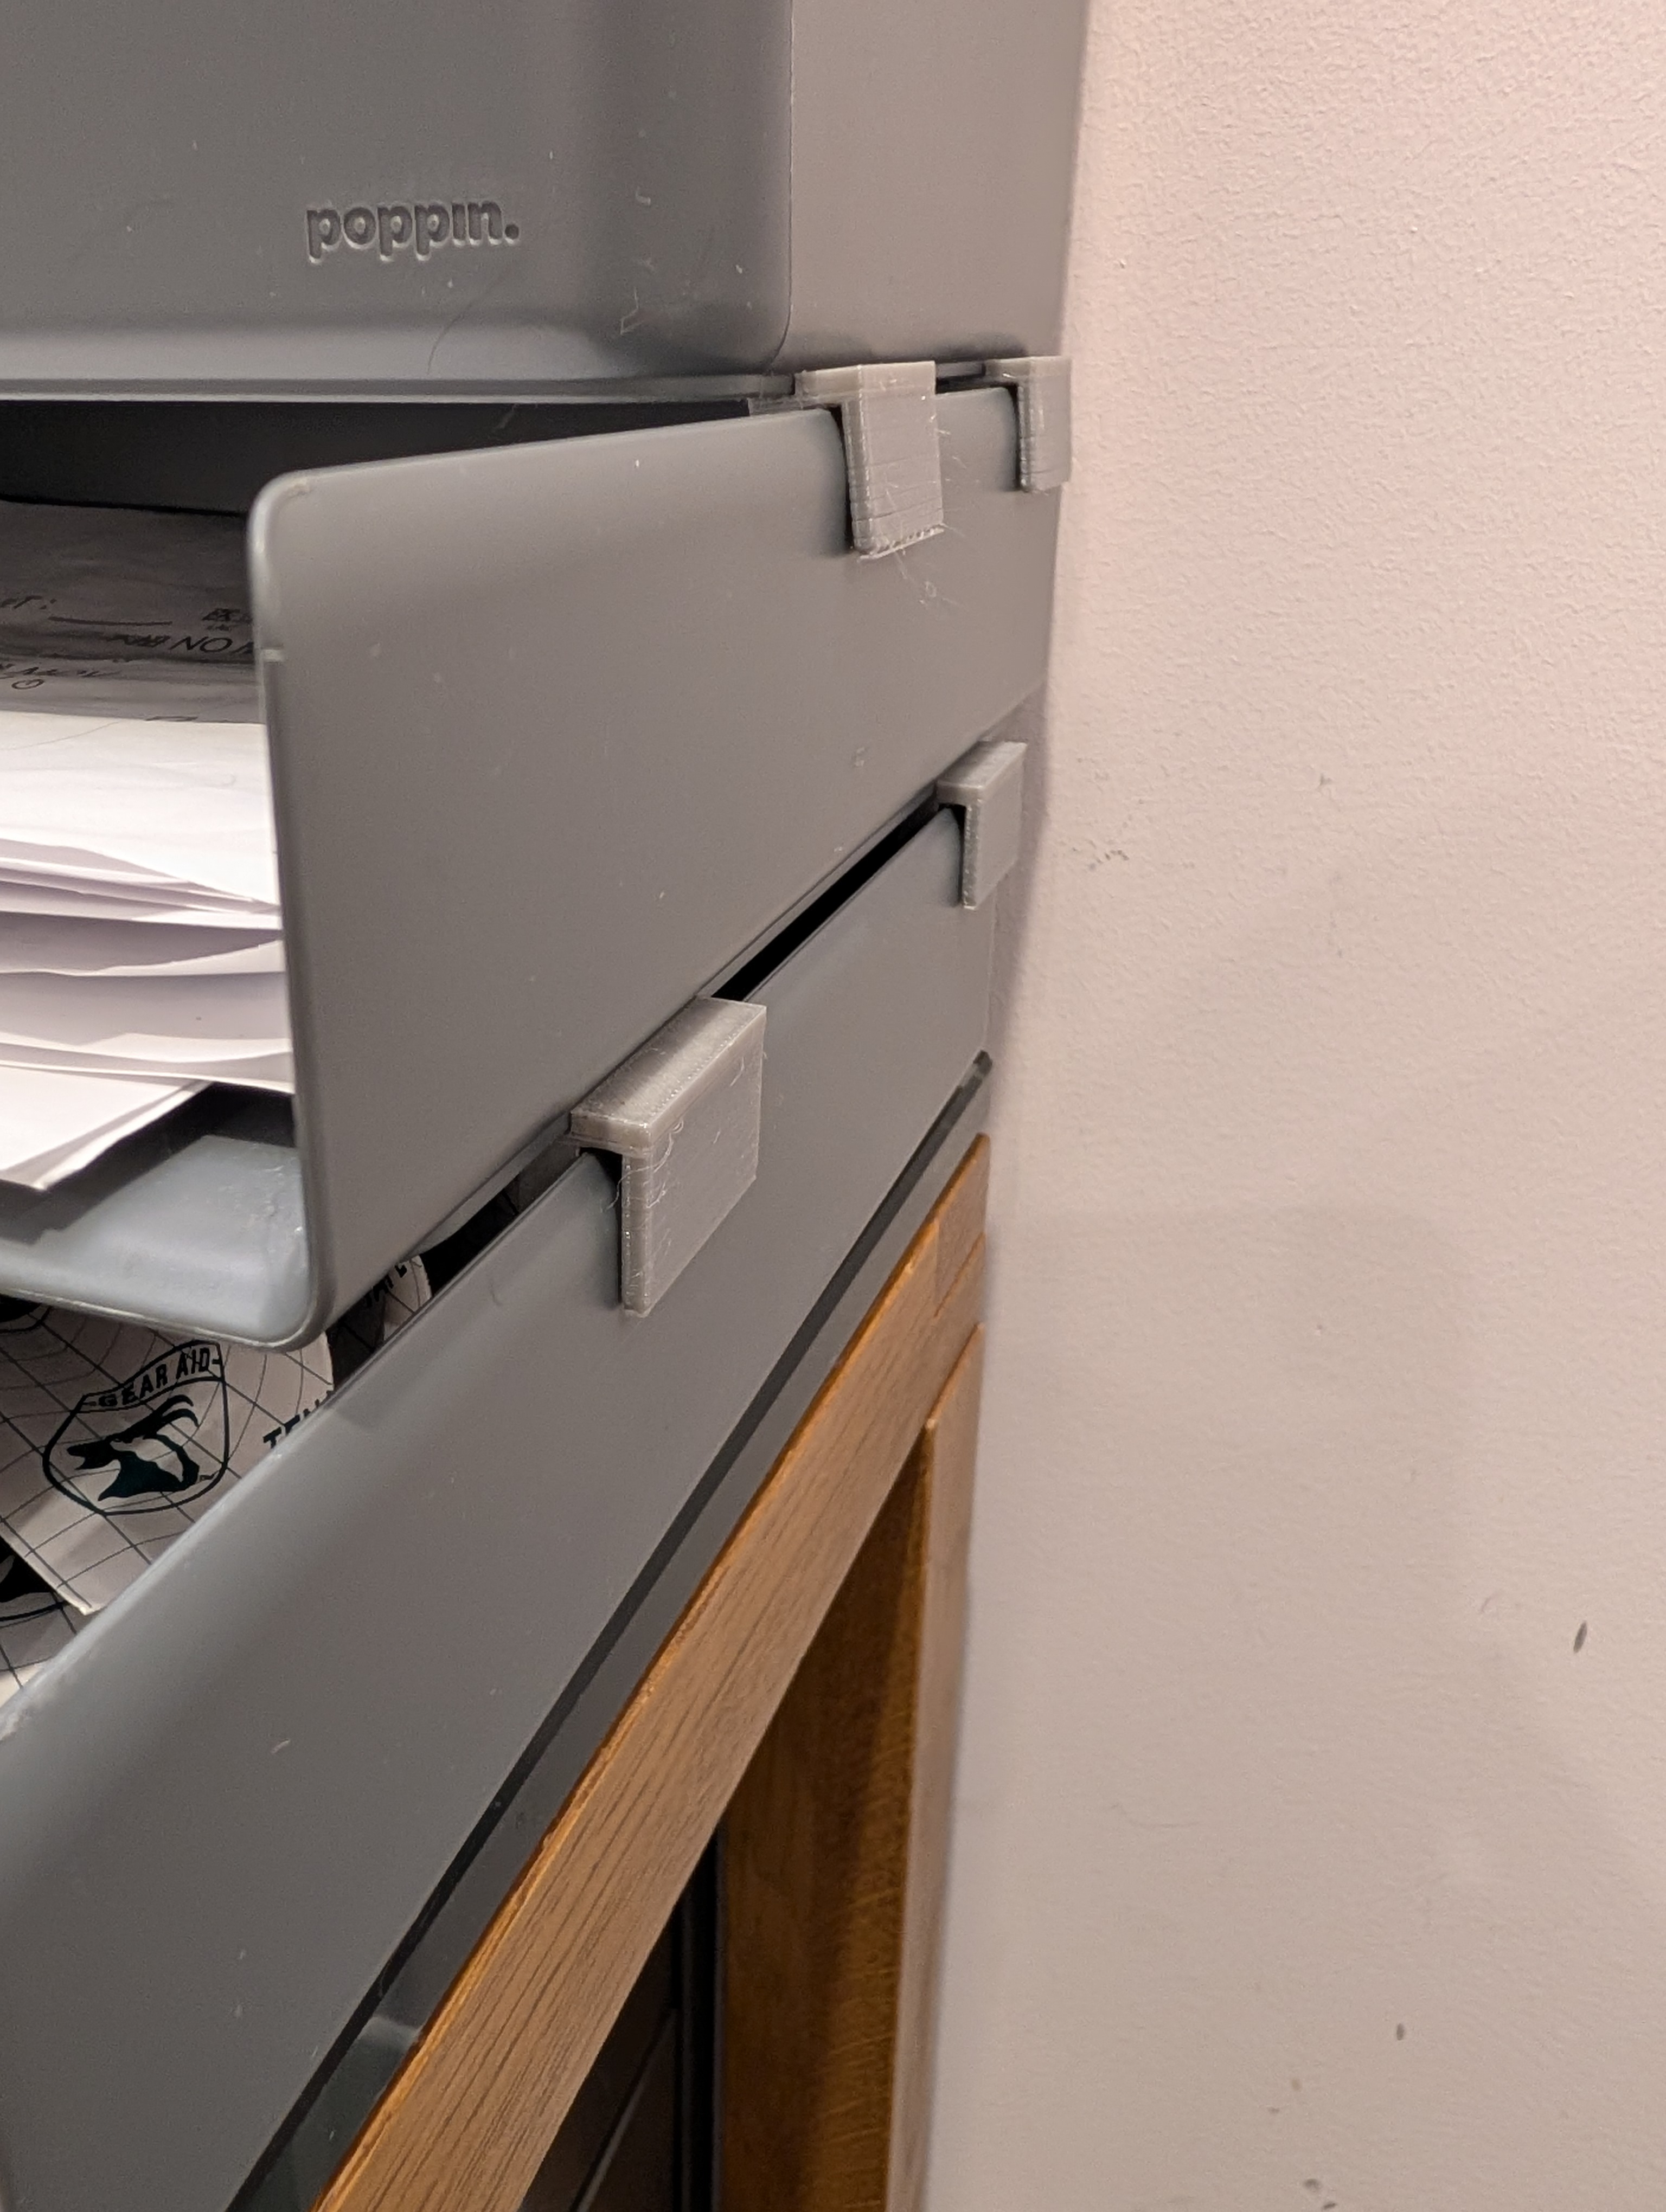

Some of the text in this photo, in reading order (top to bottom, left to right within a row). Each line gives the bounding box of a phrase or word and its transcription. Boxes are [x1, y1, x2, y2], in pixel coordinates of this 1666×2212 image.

[306, 201, 520, 263] poppin.
[98, 1347, 210, 1407] GEAR AID
